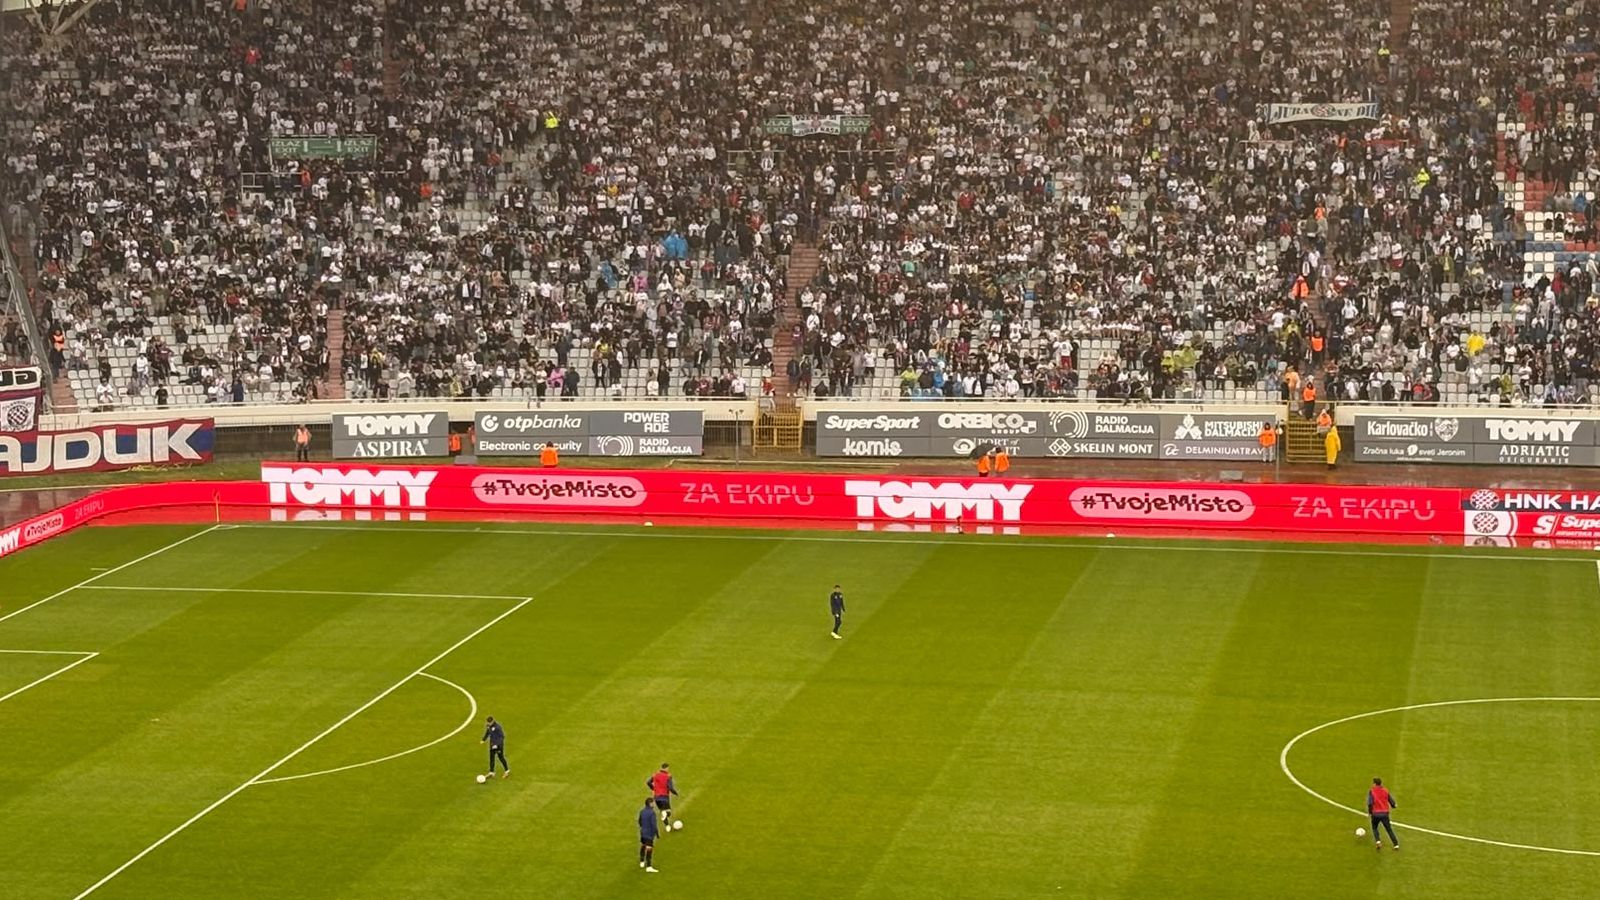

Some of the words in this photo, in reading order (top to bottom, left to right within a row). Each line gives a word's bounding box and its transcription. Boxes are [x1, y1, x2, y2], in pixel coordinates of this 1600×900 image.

[343, 413, 436, 437] TOMMY
[504, 415, 582, 432] otpbanka
[623, 412, 669, 423] POWER
[825, 415, 920, 431] SuperSport
[938, 413, 1024, 429] ORBICO
[1095, 416, 1129, 425] RADIO
[1204, 421, 1263, 430] MITSUBISHI
[1095, 424, 1154, 434] DALMACIJA
[1367, 420, 1428, 437] Karlovačko
[1485, 419, 1581, 442] TOMMY
[353, 440, 427, 457] ASPIRA
[479, 440, 530, 451] Electronic
[639, 438, 669, 446] RADIO
[639, 445, 693, 454] DALMACIJA
[842, 438, 903, 456] komis
[1073, 442, 1115, 454] SKELIN
[1119, 444, 1154, 454] MONT
[1500, 445, 1570, 457] ADRIATIC
[262, 467, 438, 506] TOMMY
[483, 479, 637, 500] #TvojeMisto
[680, 483, 720, 503] ZA
[727, 484, 815, 505] EKIPU
[845, 481, 1034, 521] TOMMY
[1081, 493, 1245, 514] #TvojeMisto
[1291, 497, 1333, 518] ZA
[1340, 498, 1436, 521] EKIPU
[1505, 494, 1562, 510] HNK
